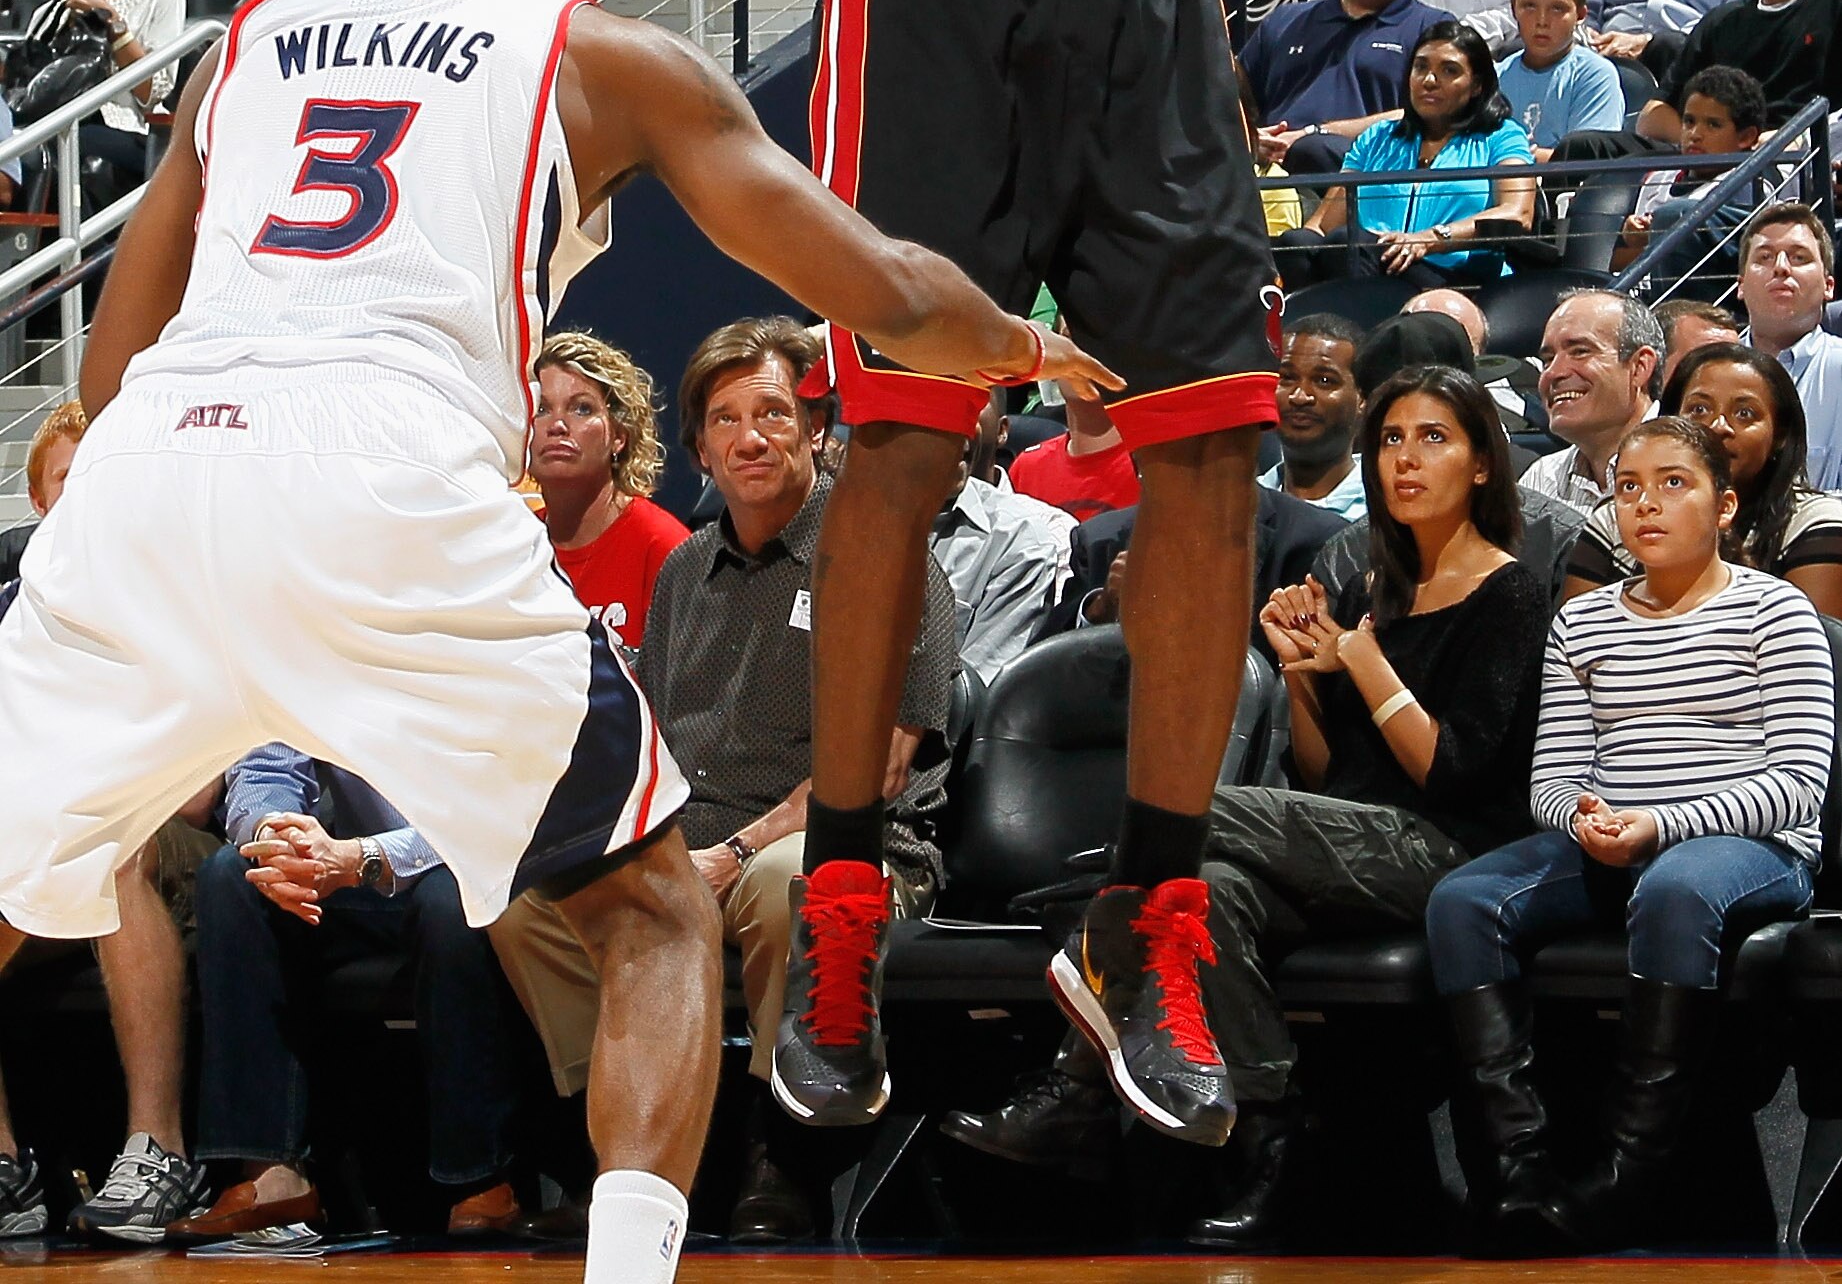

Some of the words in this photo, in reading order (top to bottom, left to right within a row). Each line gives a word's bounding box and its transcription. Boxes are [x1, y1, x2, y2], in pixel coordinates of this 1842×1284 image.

[274, 21, 495, 83] WILKINS
[248, 97, 422, 261] 3
[173, 403, 248, 432] ATL
